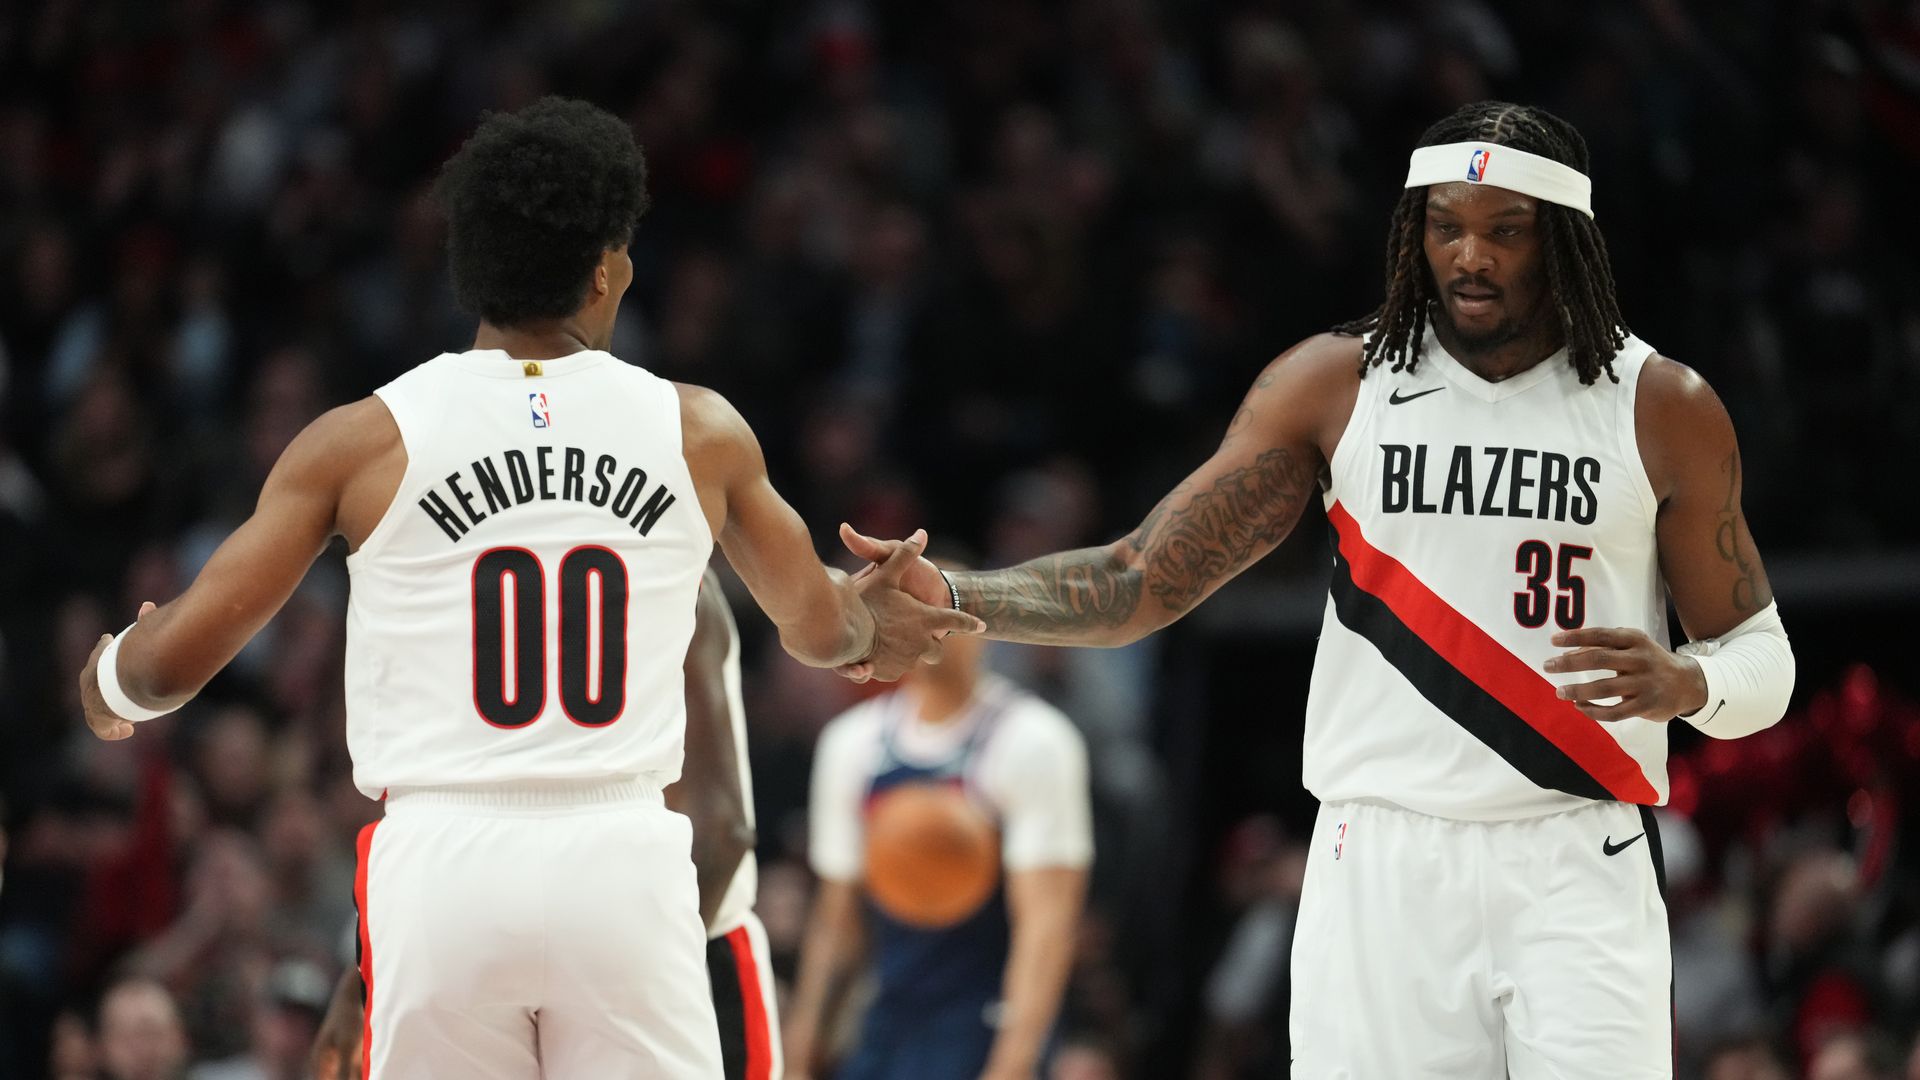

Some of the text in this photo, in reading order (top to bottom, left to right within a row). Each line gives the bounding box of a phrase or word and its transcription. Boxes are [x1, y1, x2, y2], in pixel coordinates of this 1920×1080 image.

[418, 446, 675, 543] HENDERSON
[1379, 444, 1601, 526] BLAZERS
[1513, 539, 1594, 630] 35
[471, 544, 630, 730] 00
